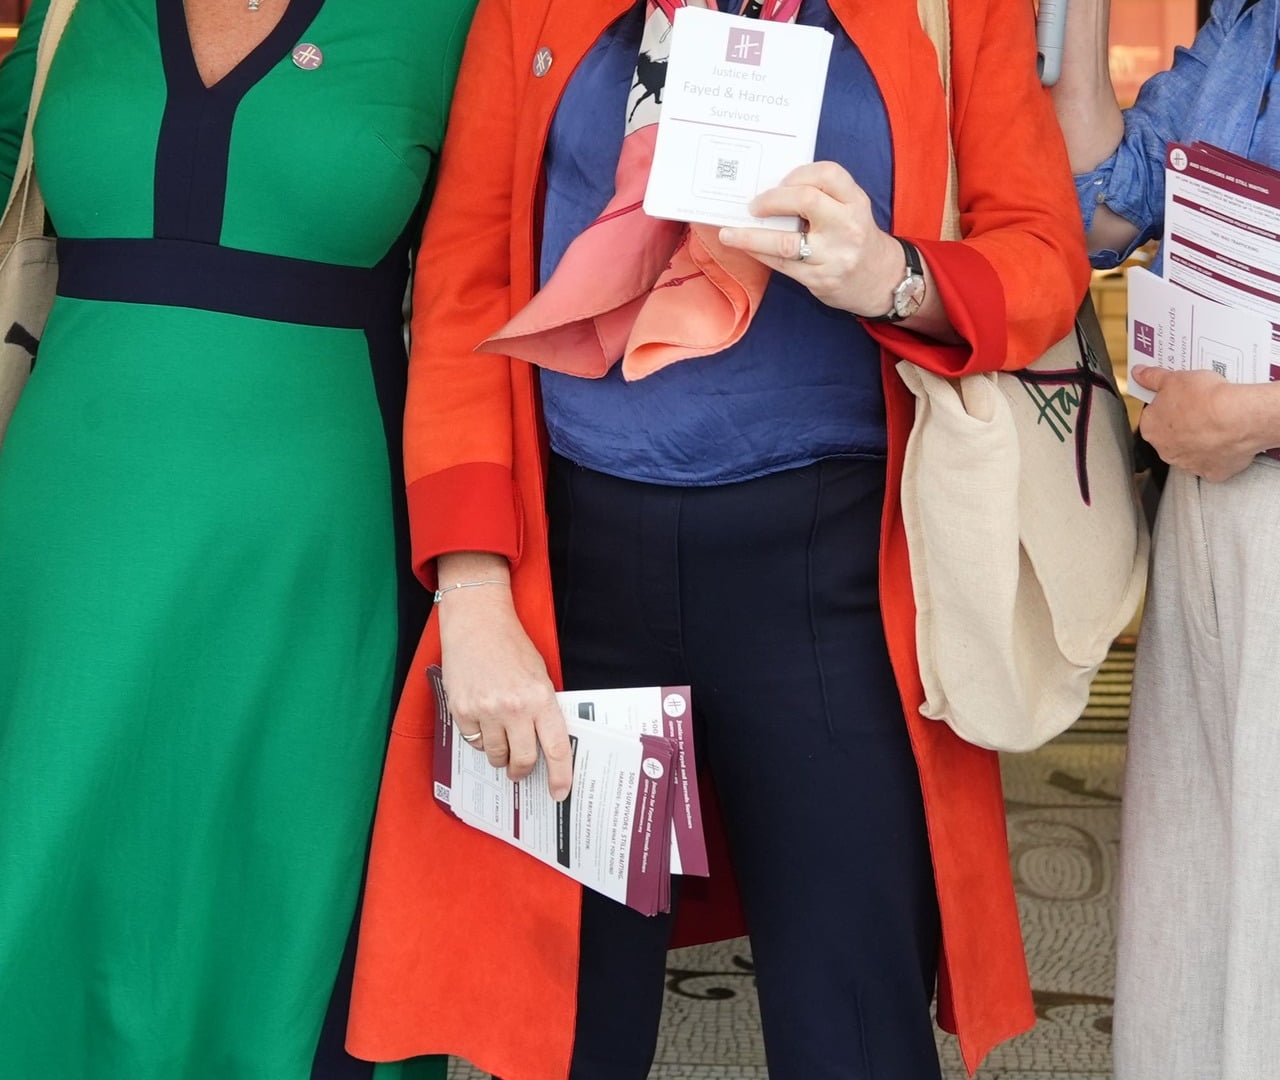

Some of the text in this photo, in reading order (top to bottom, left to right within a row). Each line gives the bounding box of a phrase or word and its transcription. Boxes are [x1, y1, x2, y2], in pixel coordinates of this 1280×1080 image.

[712, 66, 767, 81] Justice for
[683, 81, 790, 106] Fayed & Harrods
[709, 106, 760, 122] Survivors
[1168, 355, 1175, 364] &
